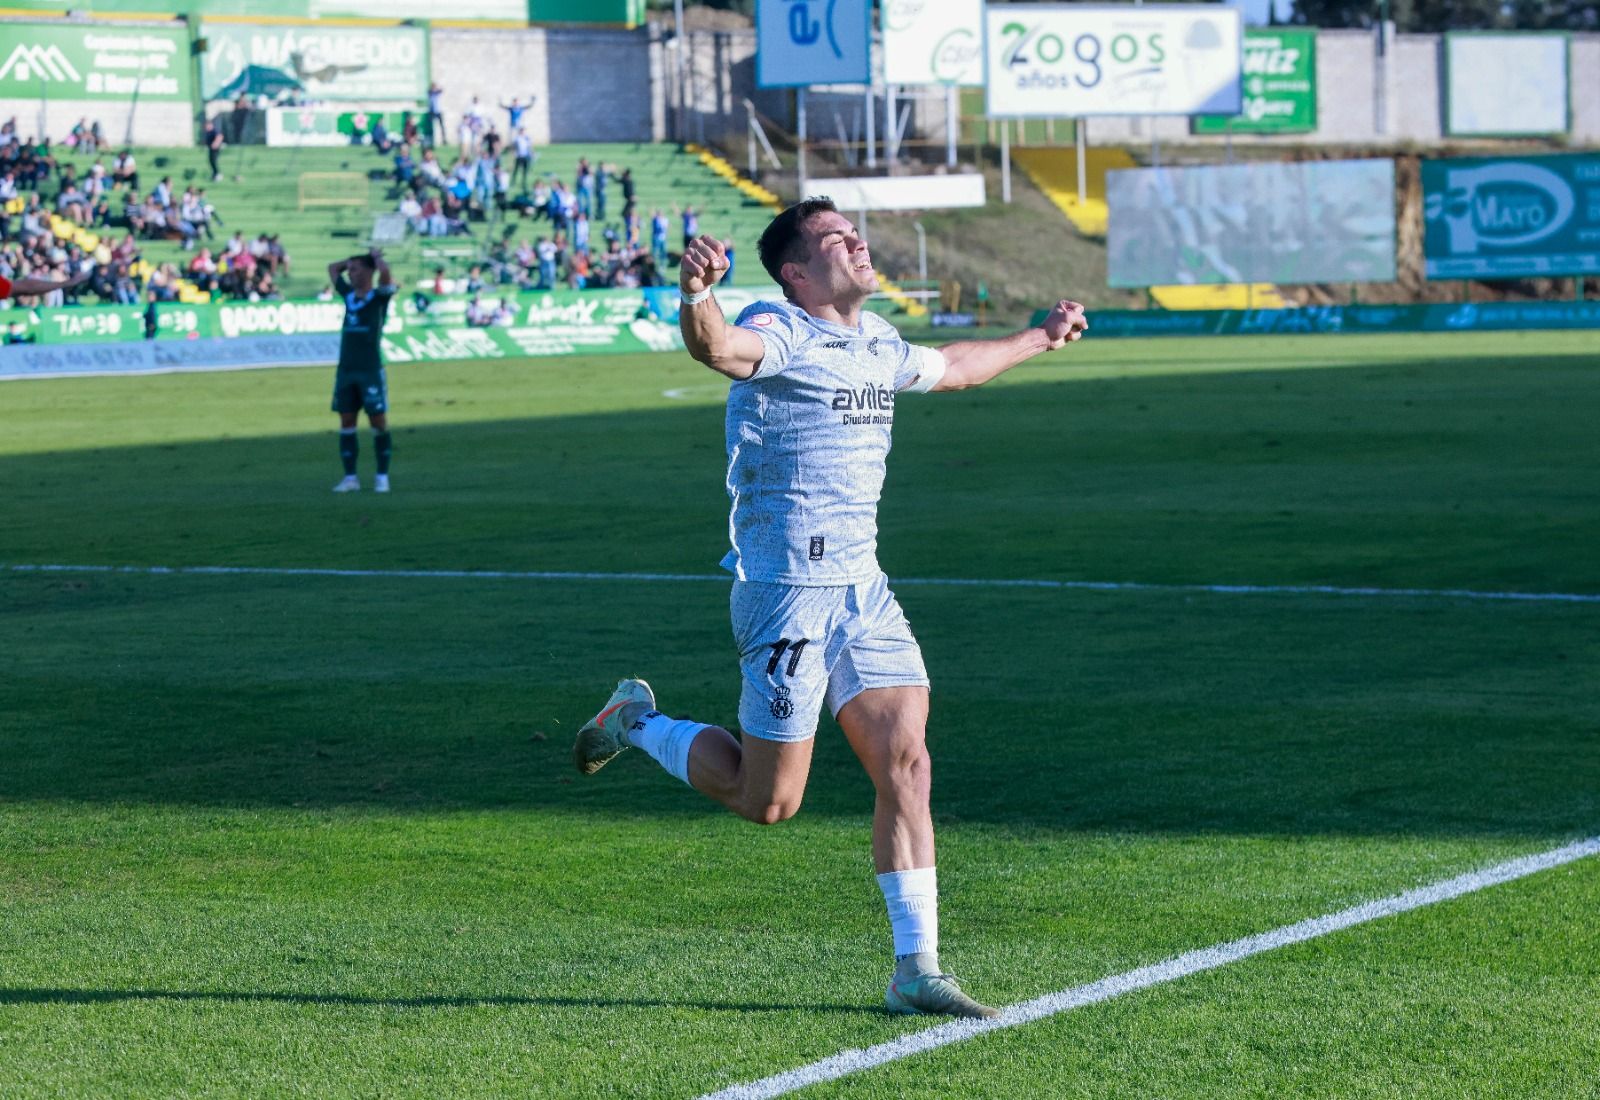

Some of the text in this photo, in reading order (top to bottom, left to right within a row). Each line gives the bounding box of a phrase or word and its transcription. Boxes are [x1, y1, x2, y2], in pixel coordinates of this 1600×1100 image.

[1017, 70, 1069, 89] años
[843, 414, 871, 425] Ciudad
[766, 637, 810, 677] 11
